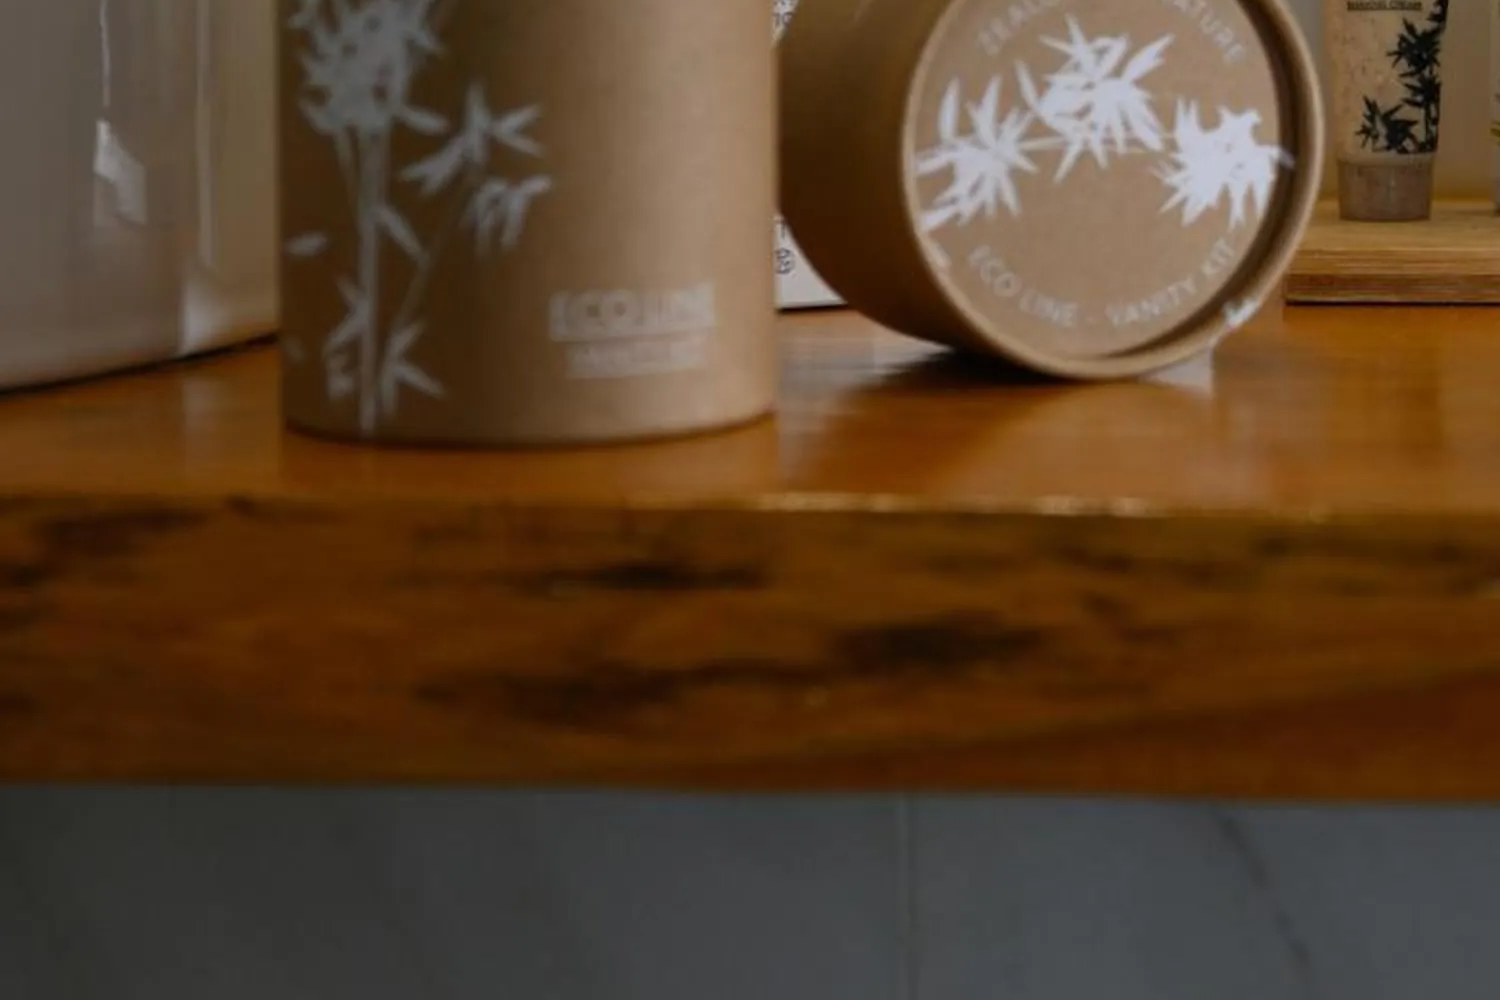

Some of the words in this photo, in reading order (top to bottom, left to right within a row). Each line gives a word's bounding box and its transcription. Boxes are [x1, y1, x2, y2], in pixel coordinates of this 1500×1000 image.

[967, 244, 1022, 298] ECO
[1020, 287, 1079, 328] LINE
[1105, 279, 1198, 327] VANITY
